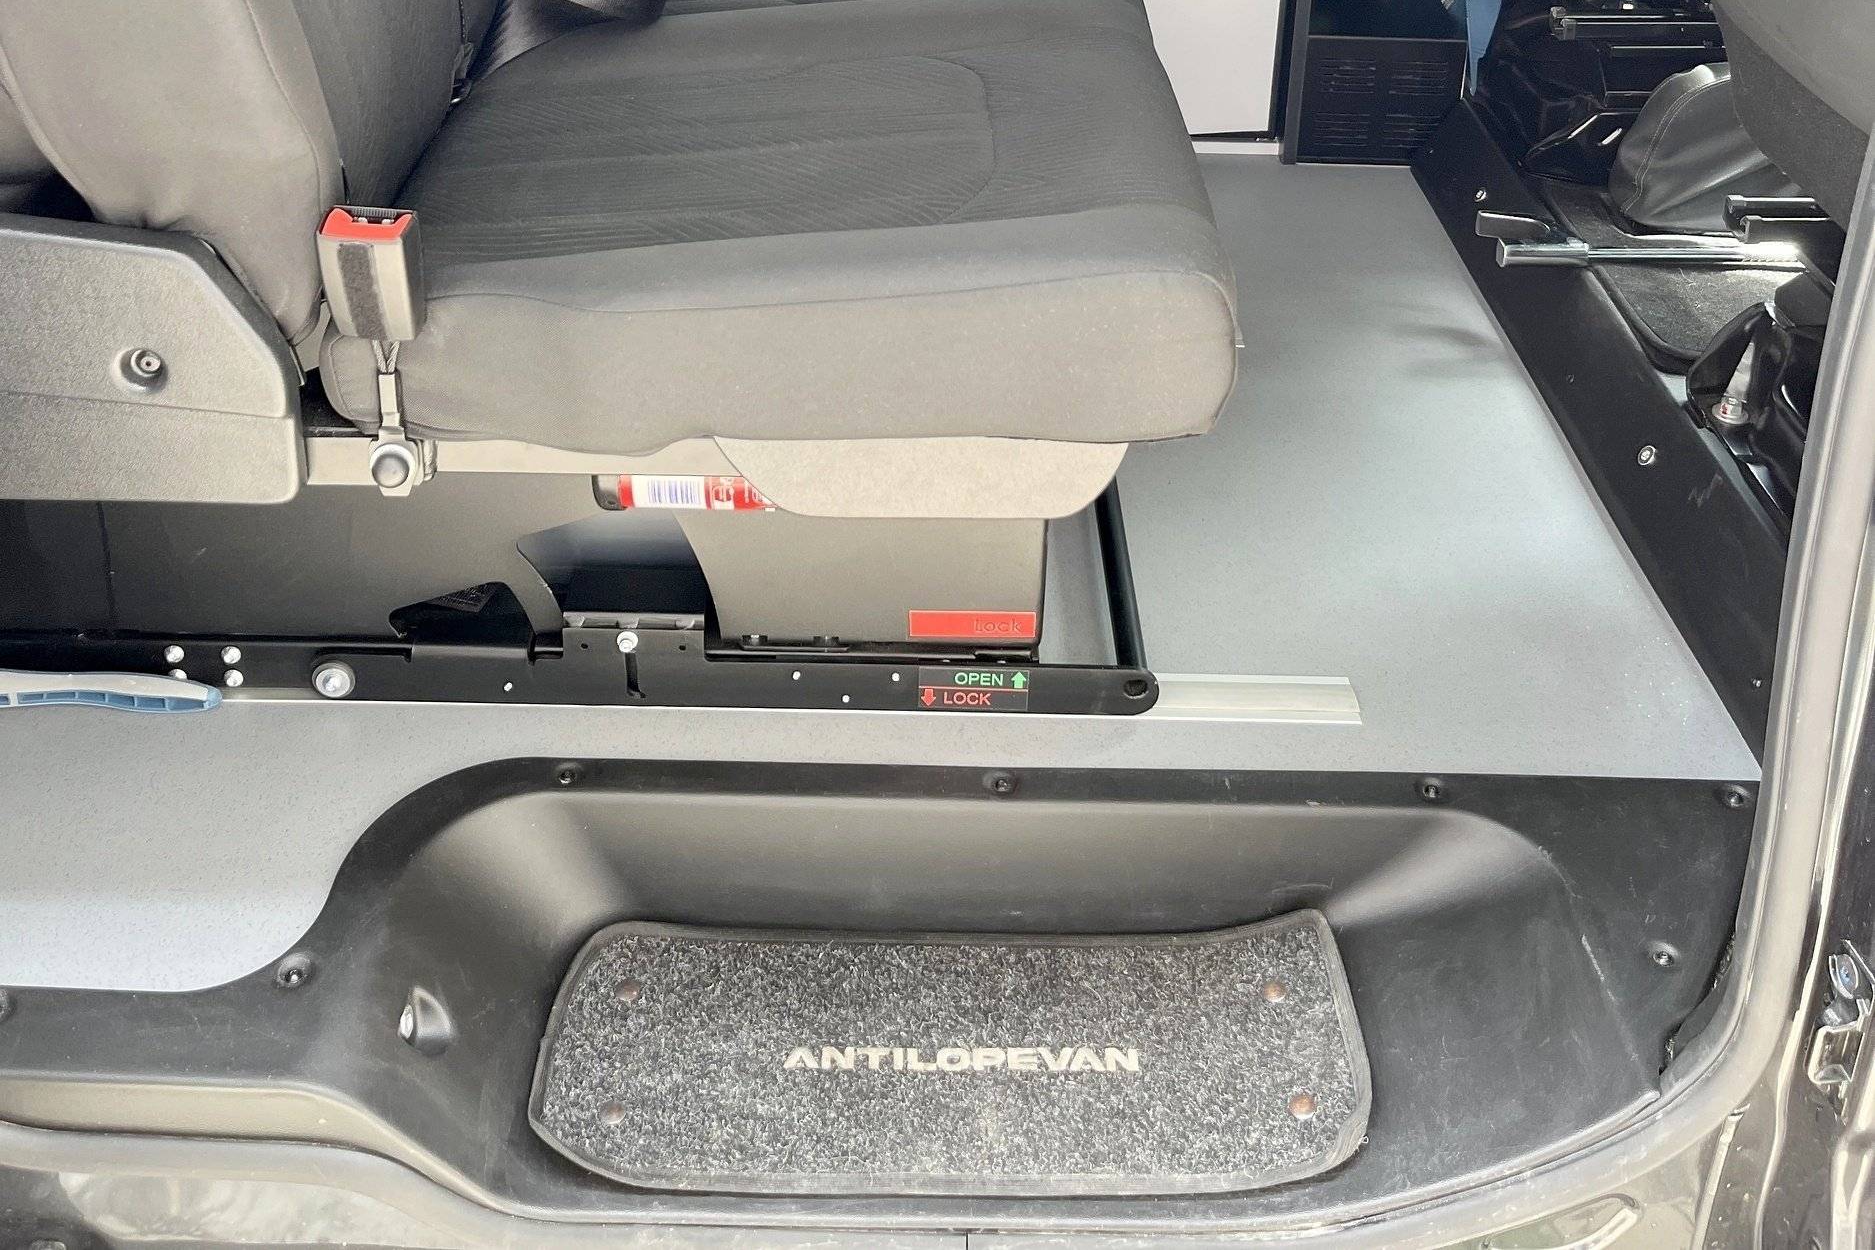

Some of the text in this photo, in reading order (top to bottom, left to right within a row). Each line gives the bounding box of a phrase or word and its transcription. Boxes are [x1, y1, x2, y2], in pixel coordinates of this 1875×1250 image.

[954, 671, 1004, 686] OPEN
[943, 691, 991, 706] LOCK
[783, 1046, 1141, 1071] ANTILOPEVAN
